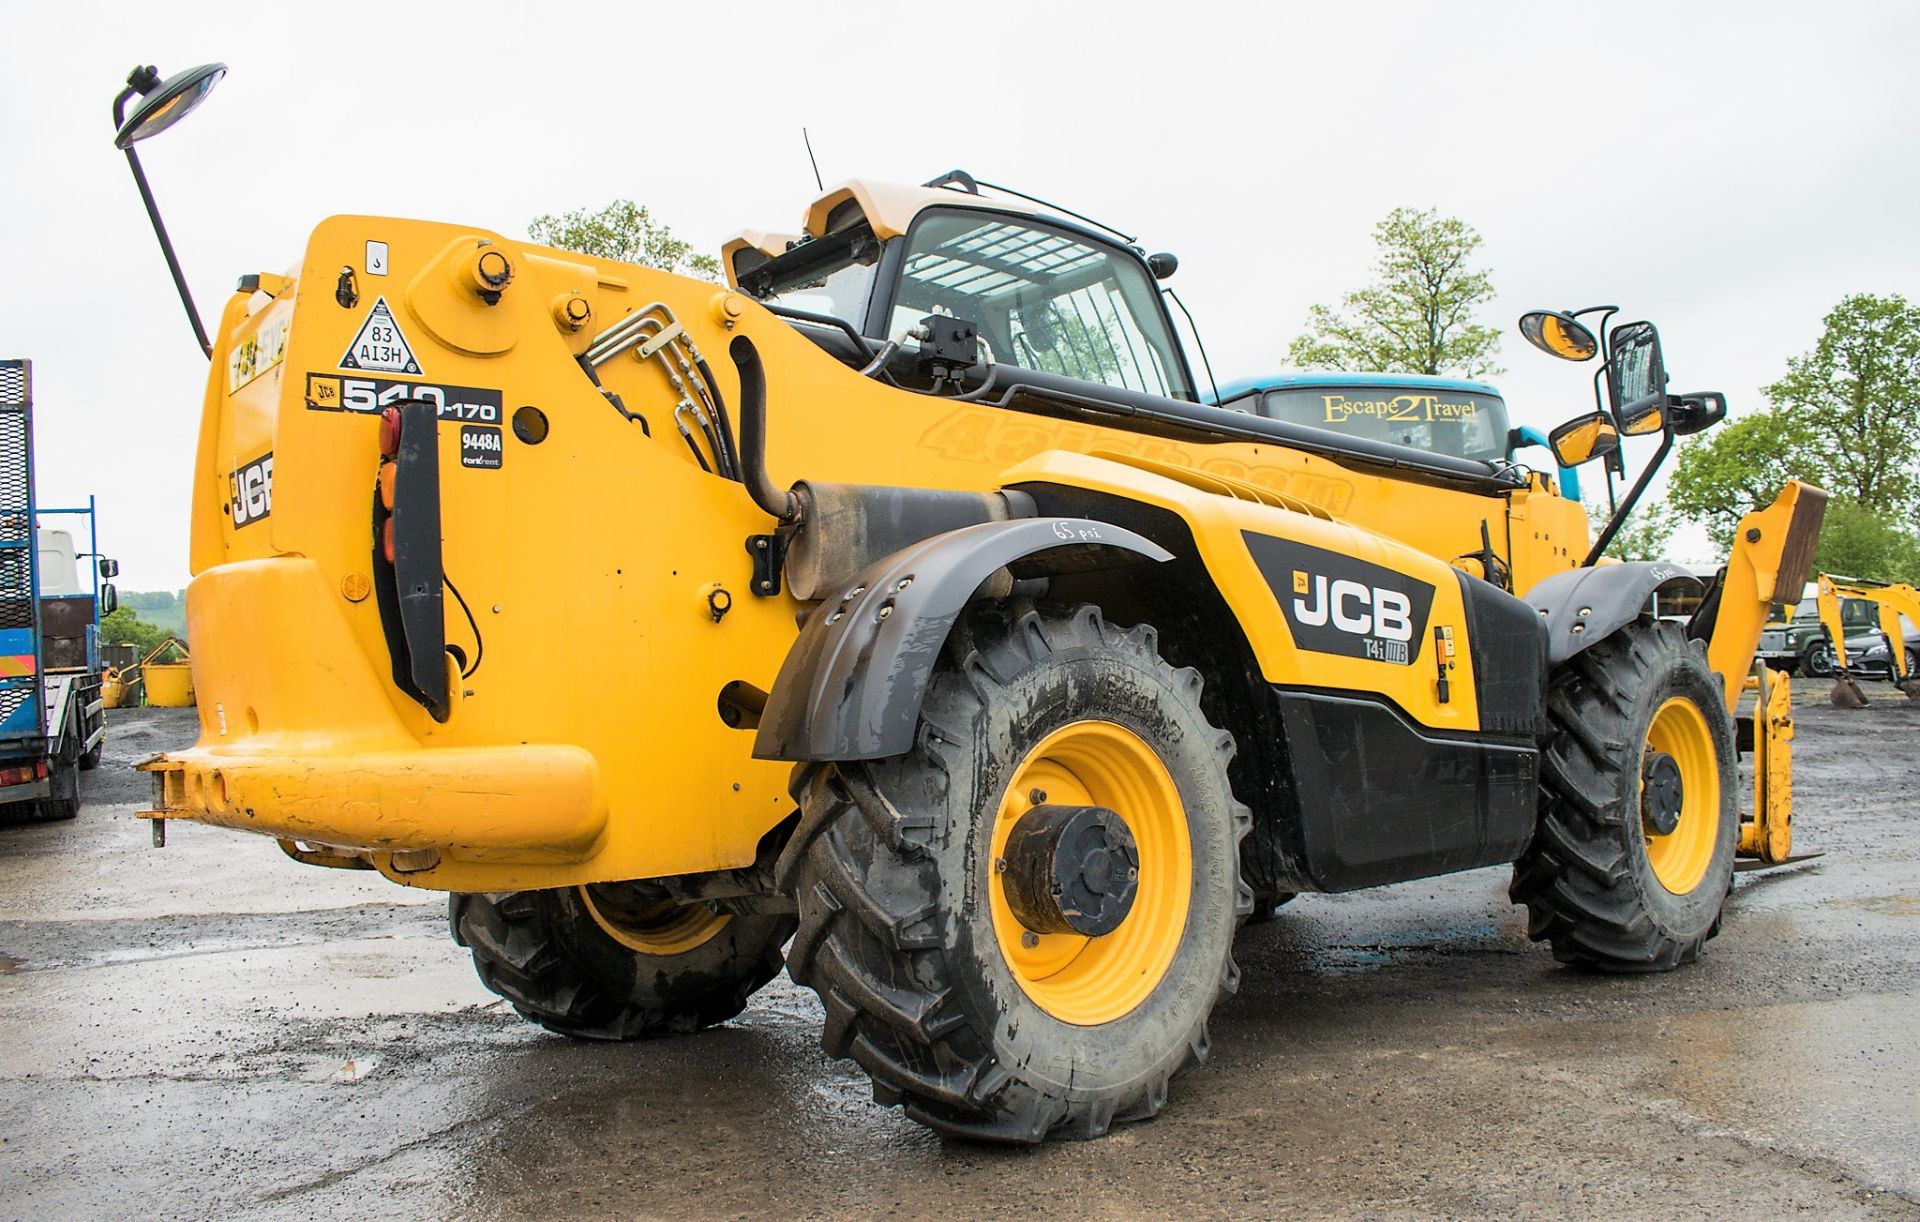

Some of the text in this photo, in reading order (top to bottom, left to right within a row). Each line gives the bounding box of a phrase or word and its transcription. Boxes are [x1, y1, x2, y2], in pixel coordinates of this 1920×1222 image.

[372, 326, 392, 343] 83
[318, 384, 336, 399] JCB
[462, 433, 502, 452] 9448A
[1053, 521, 1102, 541] 65 psi
[1293, 574, 1413, 642] JCB
[1363, 638, 1385, 660] T4i
